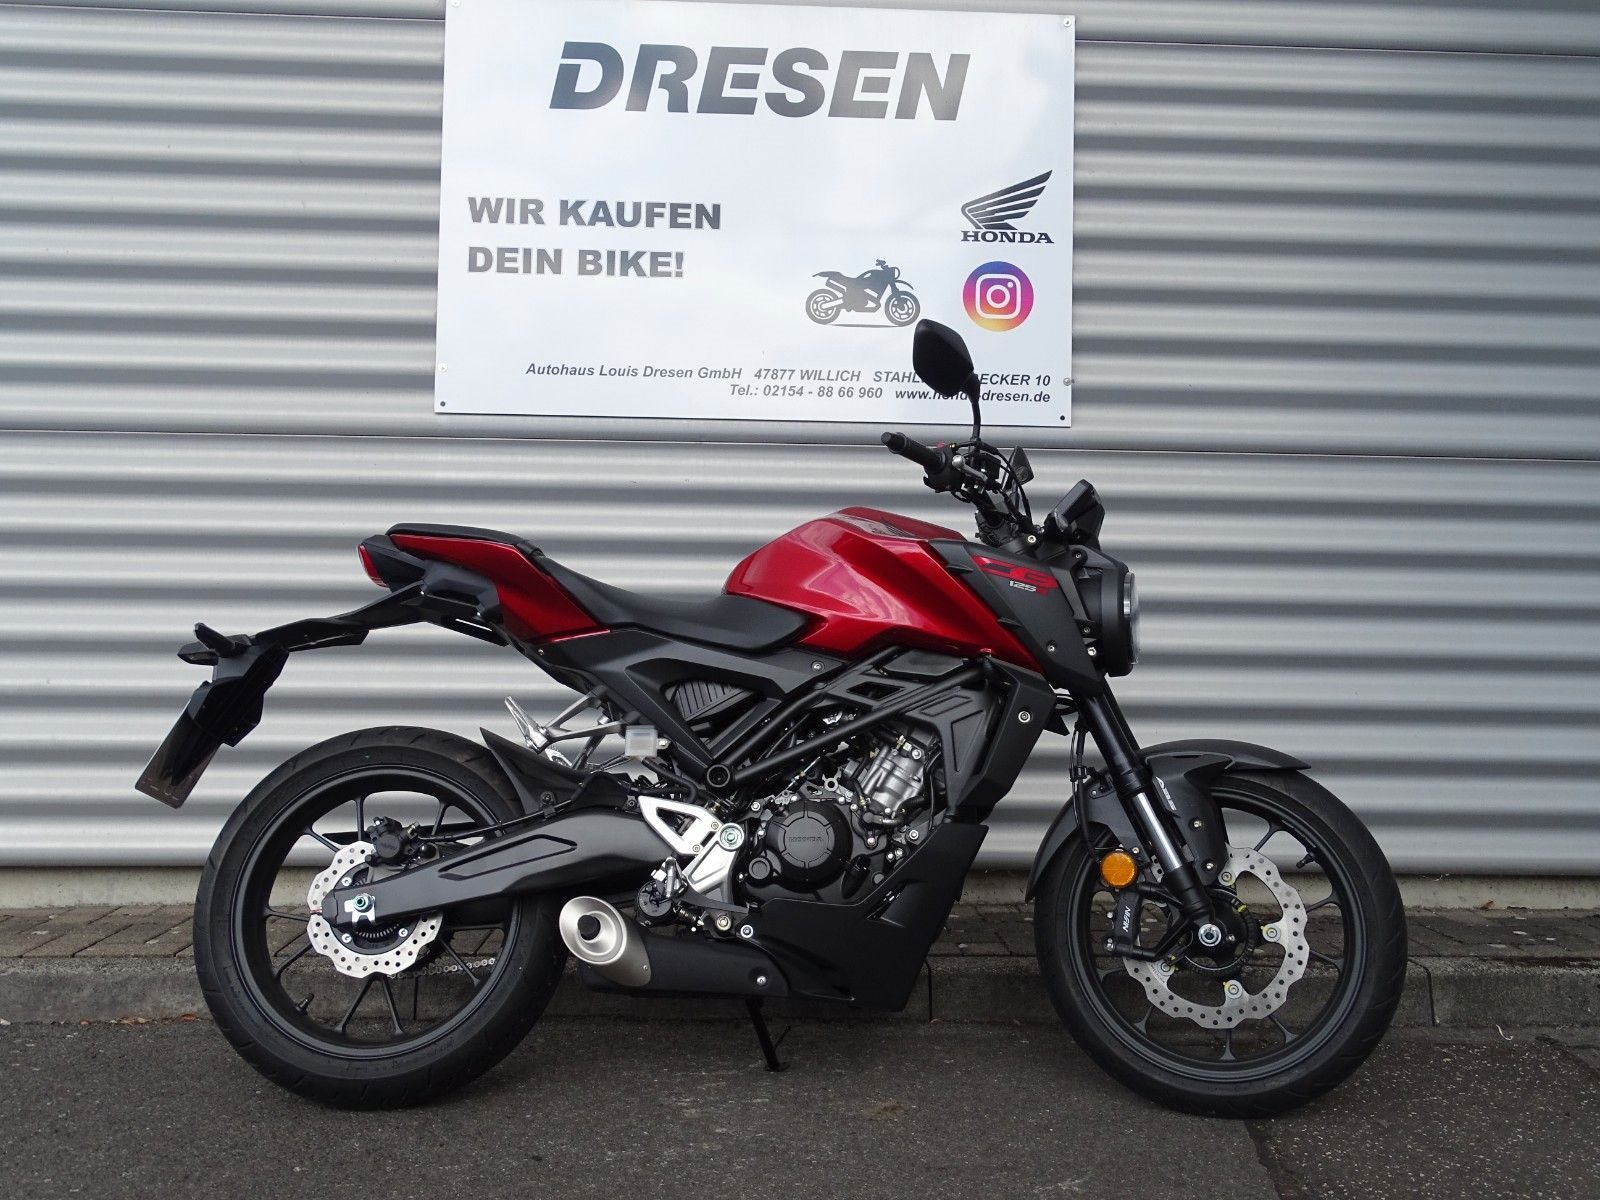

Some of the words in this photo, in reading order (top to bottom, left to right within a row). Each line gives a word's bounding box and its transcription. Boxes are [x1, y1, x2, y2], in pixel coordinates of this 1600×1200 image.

[549, 41, 970, 120] DRESEN
[468, 197, 545, 224] WIR
[560, 200, 721, 229] KAUFEN
[961, 230, 1055, 244] HONDA
[468, 246, 563, 275] DEIN
[577, 249, 684, 277] BIKE!
[526, 363, 595, 376] Autohaus
[599, 365, 638, 377] Louis
[643, 366, 693, 378] Dresen
[698, 367, 742, 380] GmbH
[754, 369, 796, 380] 47877
[801, 370, 861, 382] WILLICH
[980, 374, 1031, 387] ECKER
[1035, 375, 1051, 387] 10
[730, 384, 758, 397] Tel.:
[763, 385, 804, 398] 02154
[817, 387, 834, 399] 88
[838, 387, 855, 399] 66
[857, 388, 884, 400] 960
